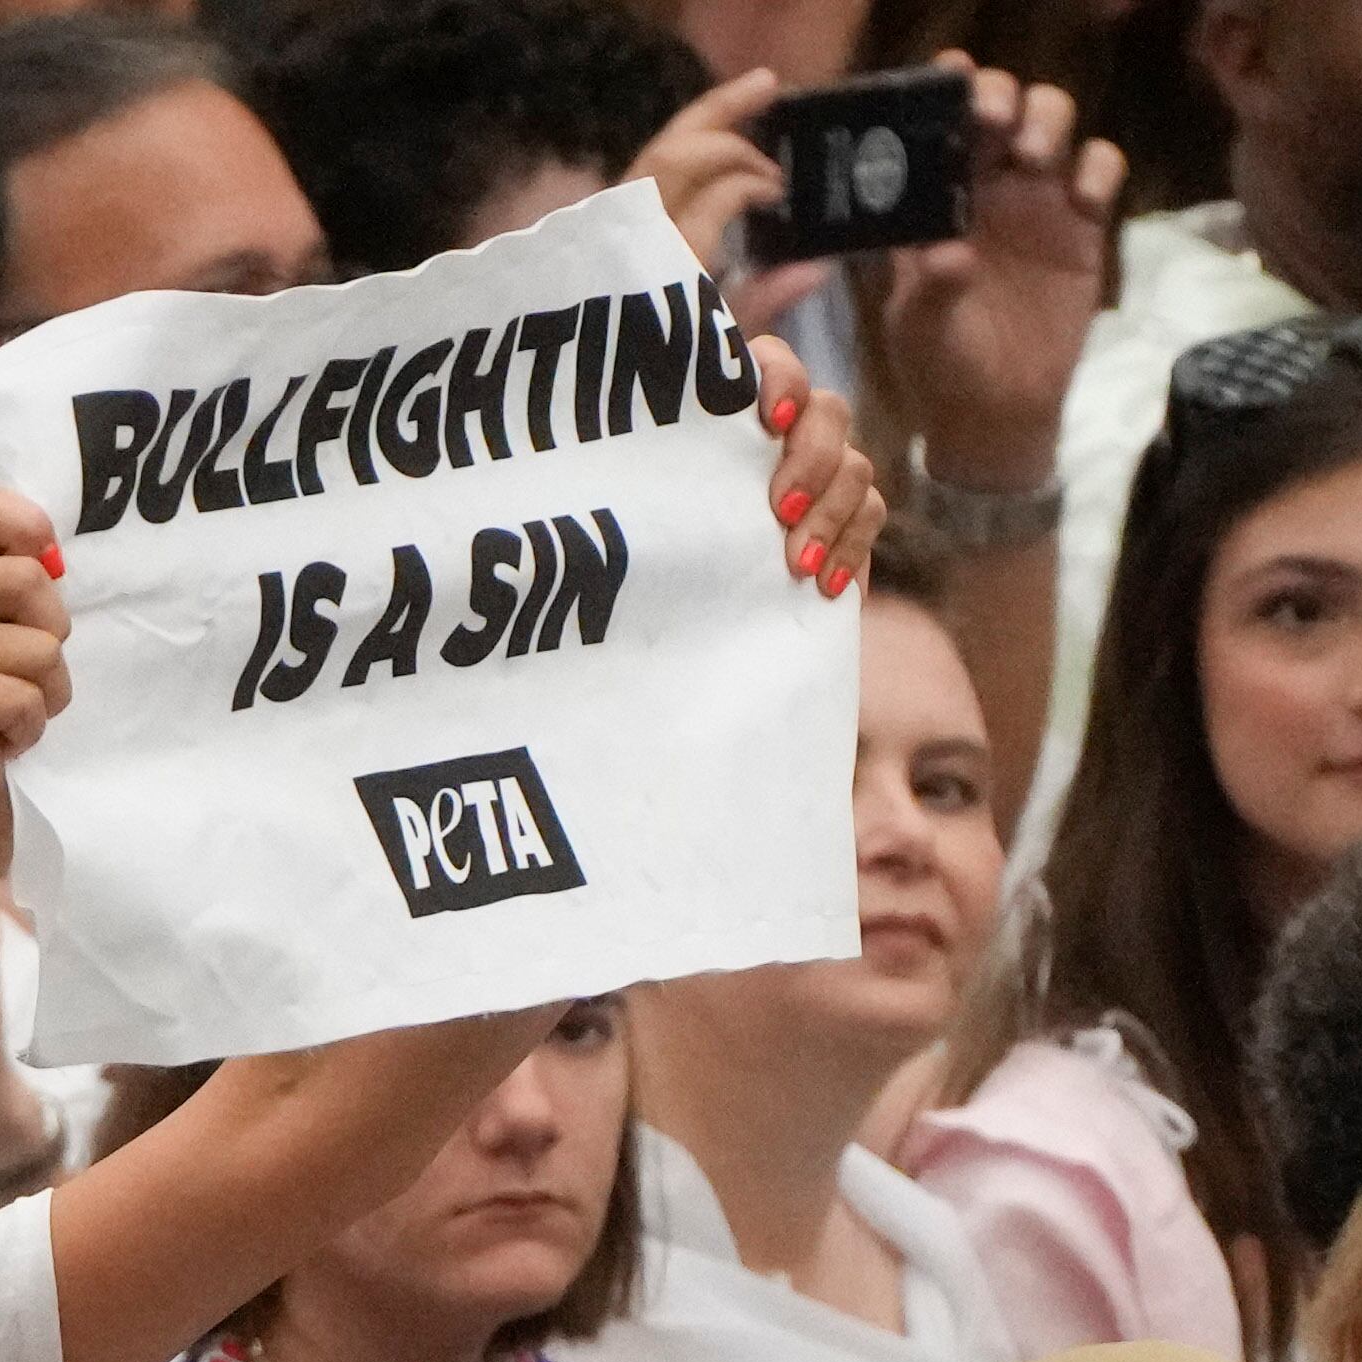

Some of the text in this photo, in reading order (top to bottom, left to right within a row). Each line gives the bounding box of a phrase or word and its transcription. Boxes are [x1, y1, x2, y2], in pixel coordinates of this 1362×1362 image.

[73, 271, 758, 536] BULLFIGHTING
[232, 508, 628, 712] IS A SIN
